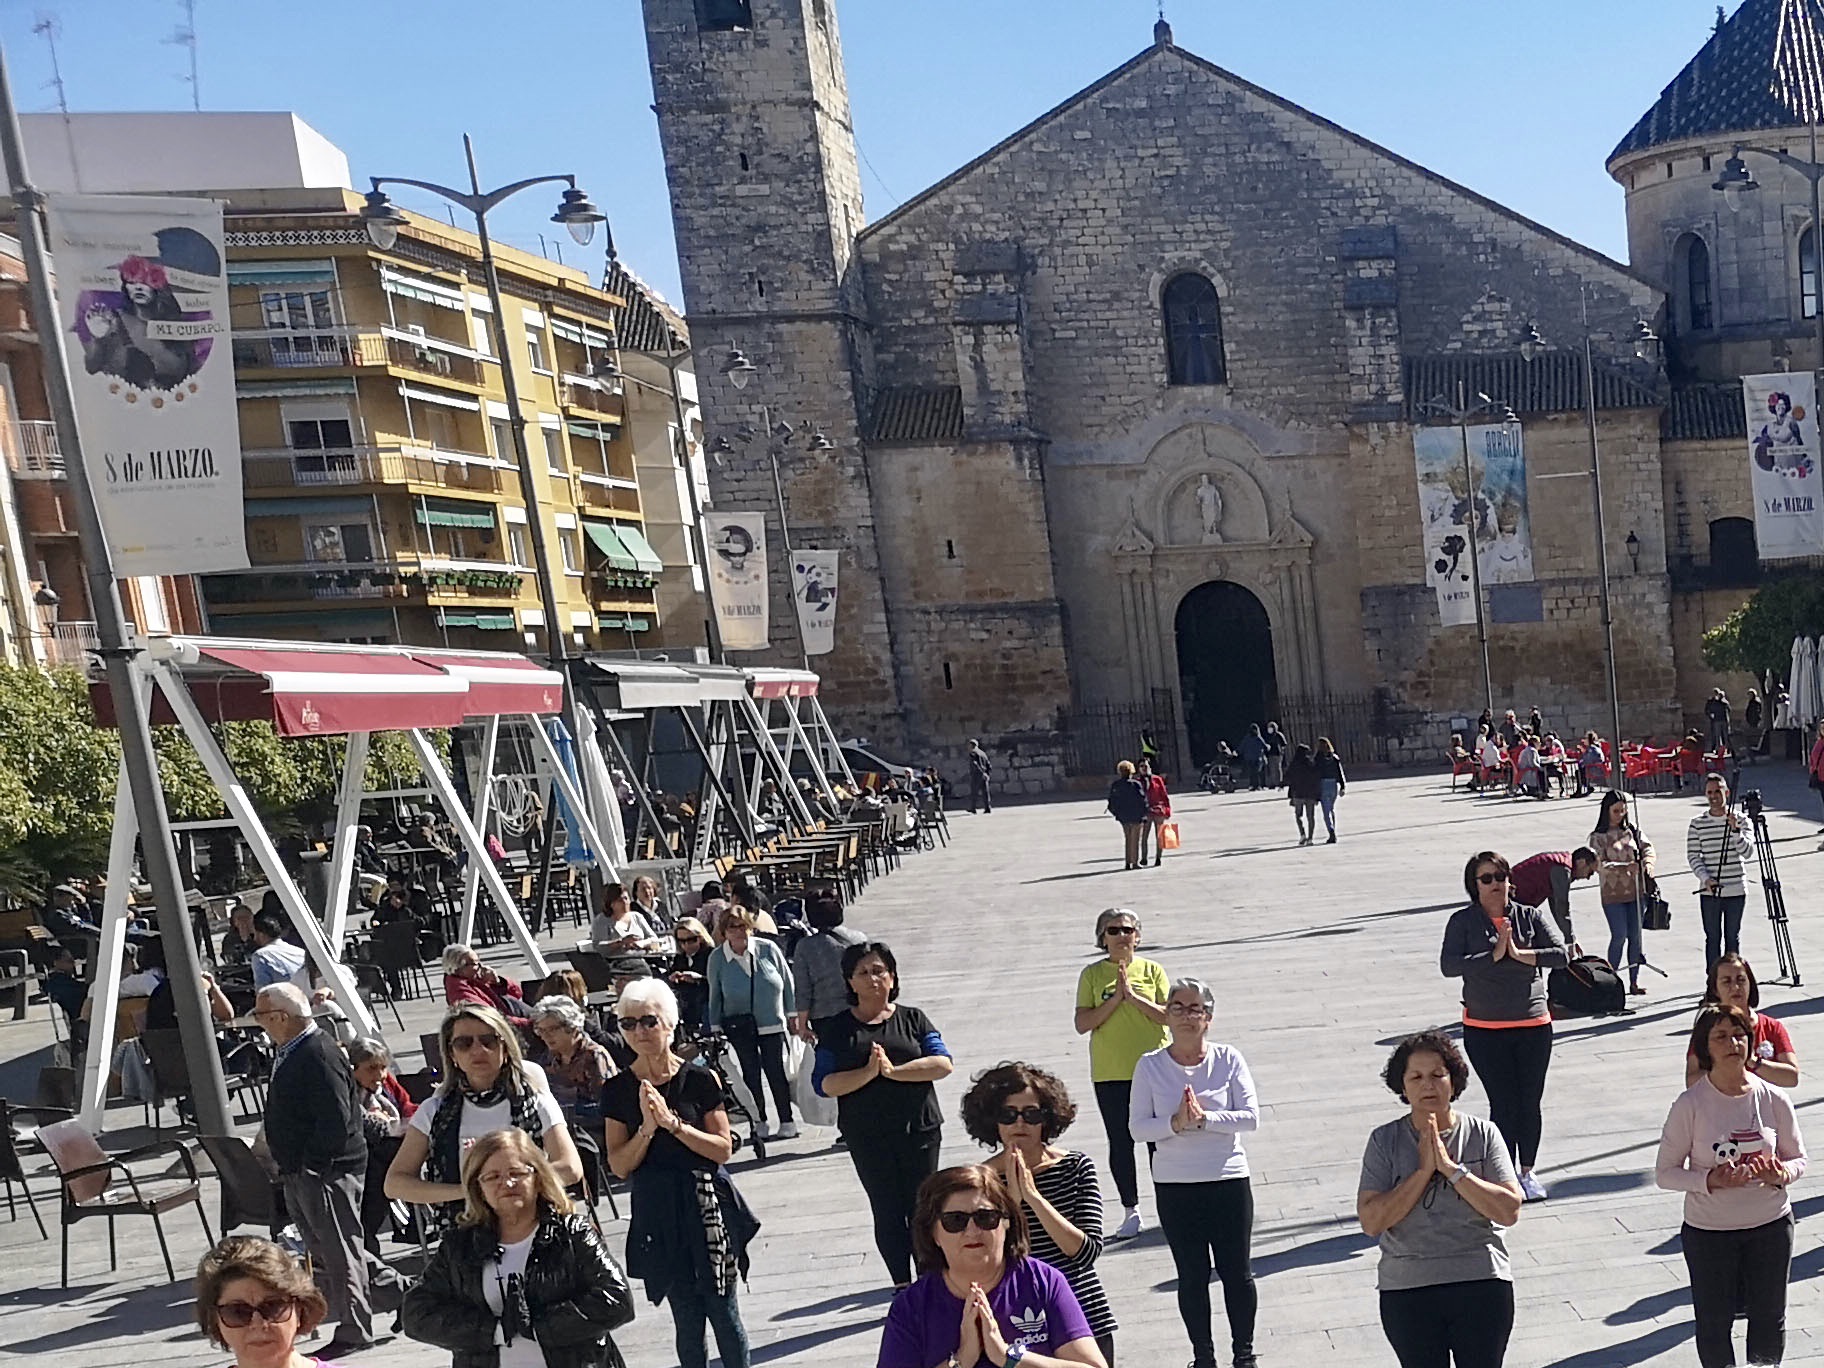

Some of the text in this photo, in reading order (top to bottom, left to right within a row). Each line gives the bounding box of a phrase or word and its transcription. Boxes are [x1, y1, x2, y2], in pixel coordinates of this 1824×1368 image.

[156, 322, 225, 337] MI CUERPO.
[104, 447, 220, 484] 8 de MARZO.
[1771, 497, 1782, 513] de
